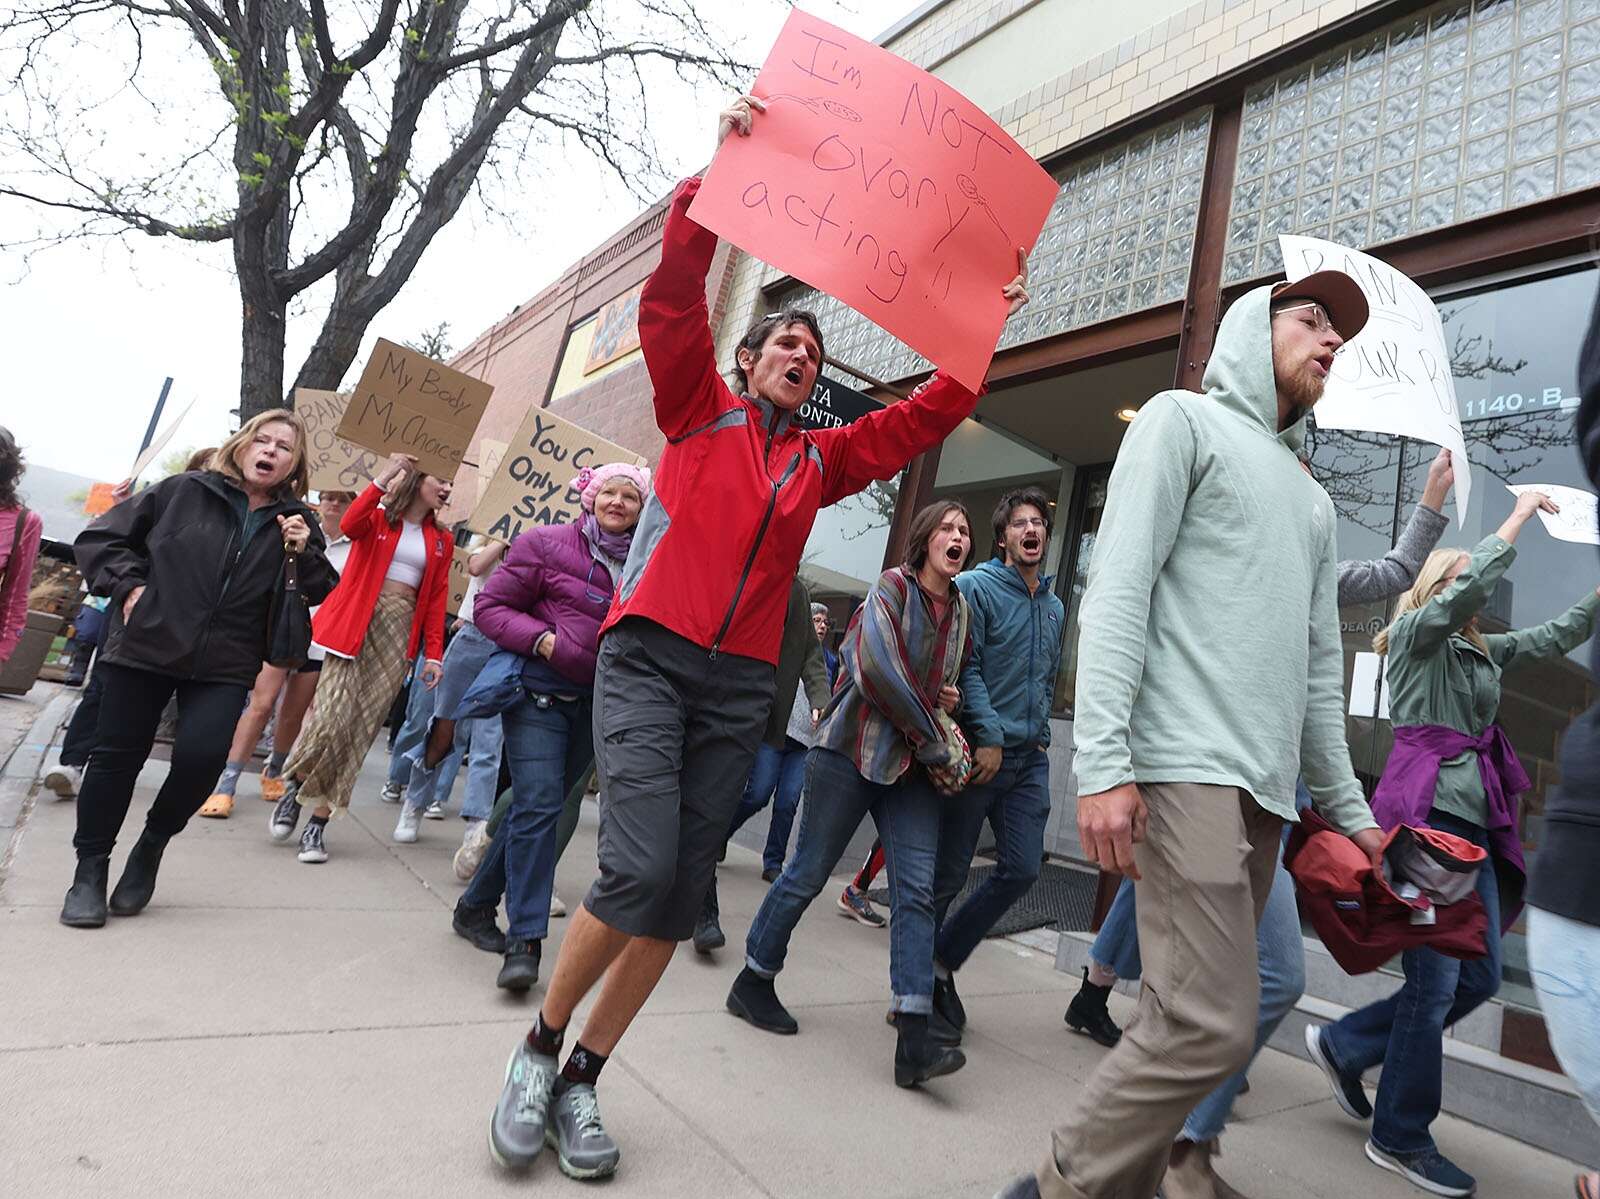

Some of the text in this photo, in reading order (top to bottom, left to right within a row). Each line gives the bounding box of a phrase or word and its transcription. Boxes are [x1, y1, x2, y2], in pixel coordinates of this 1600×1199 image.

[901, 82, 1013, 172] NOT
[378, 351, 472, 416] My Body
[811, 383, 831, 408] TA
[358, 393, 463, 463] My Choice
[530, 414, 568, 462] You
[796, 402, 851, 429] ONTR
[508, 455, 562, 503] Only
